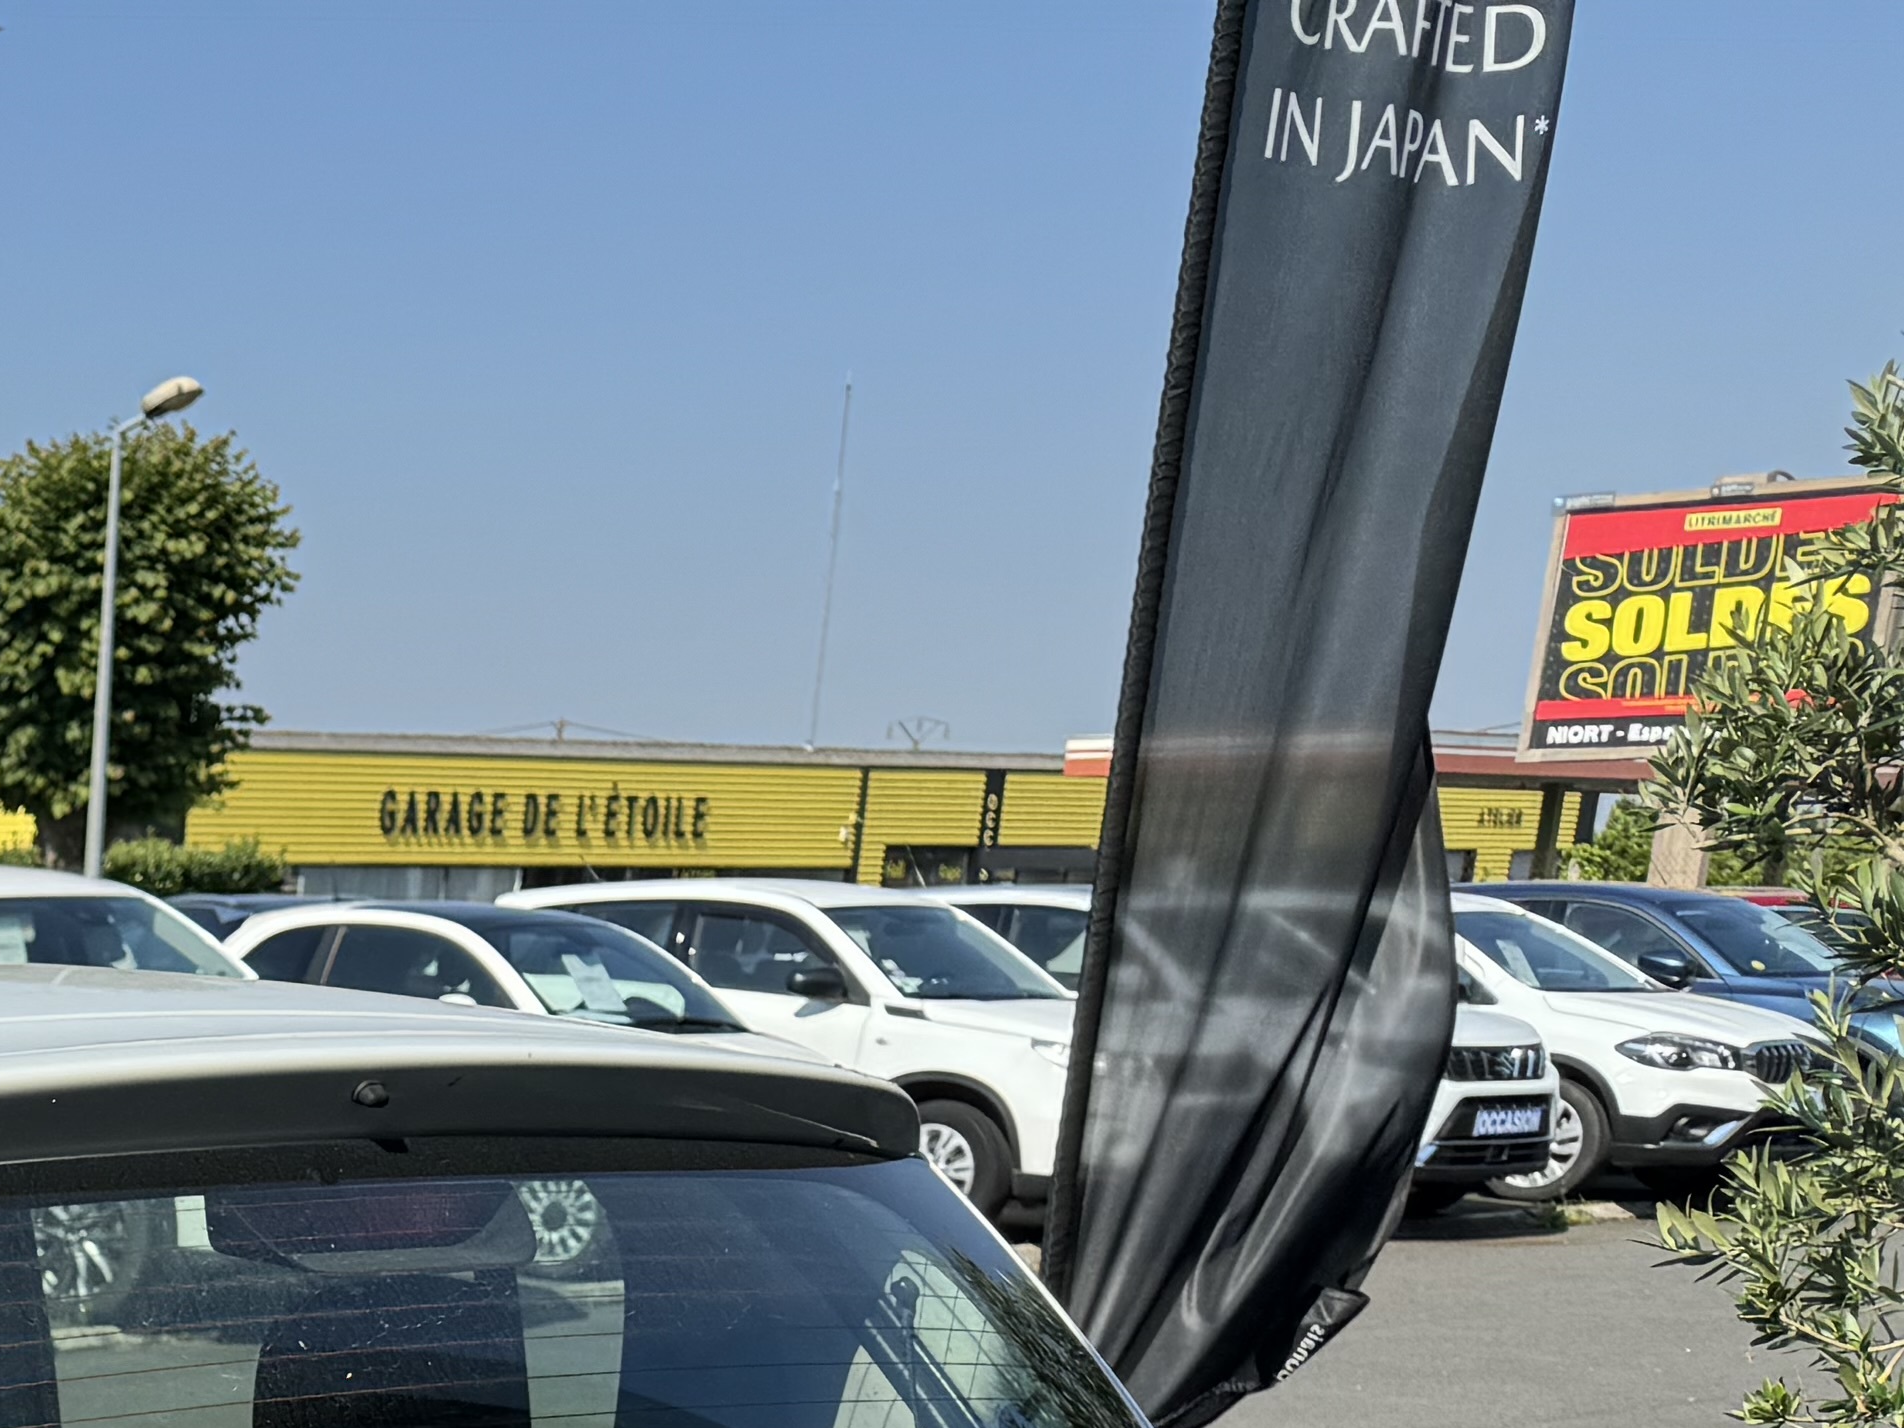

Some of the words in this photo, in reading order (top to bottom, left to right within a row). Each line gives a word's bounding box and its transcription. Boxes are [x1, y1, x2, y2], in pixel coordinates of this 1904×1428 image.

[1290, 0, 1547, 73] CRAFTED
[1264, 87, 1323, 167] IN
[1546, 725, 1614, 745] NIORT
[380, 789, 506, 836] GARAGE
[523, 793, 560, 838] DE
[577, 781, 708, 840] L'ÉTOILE
